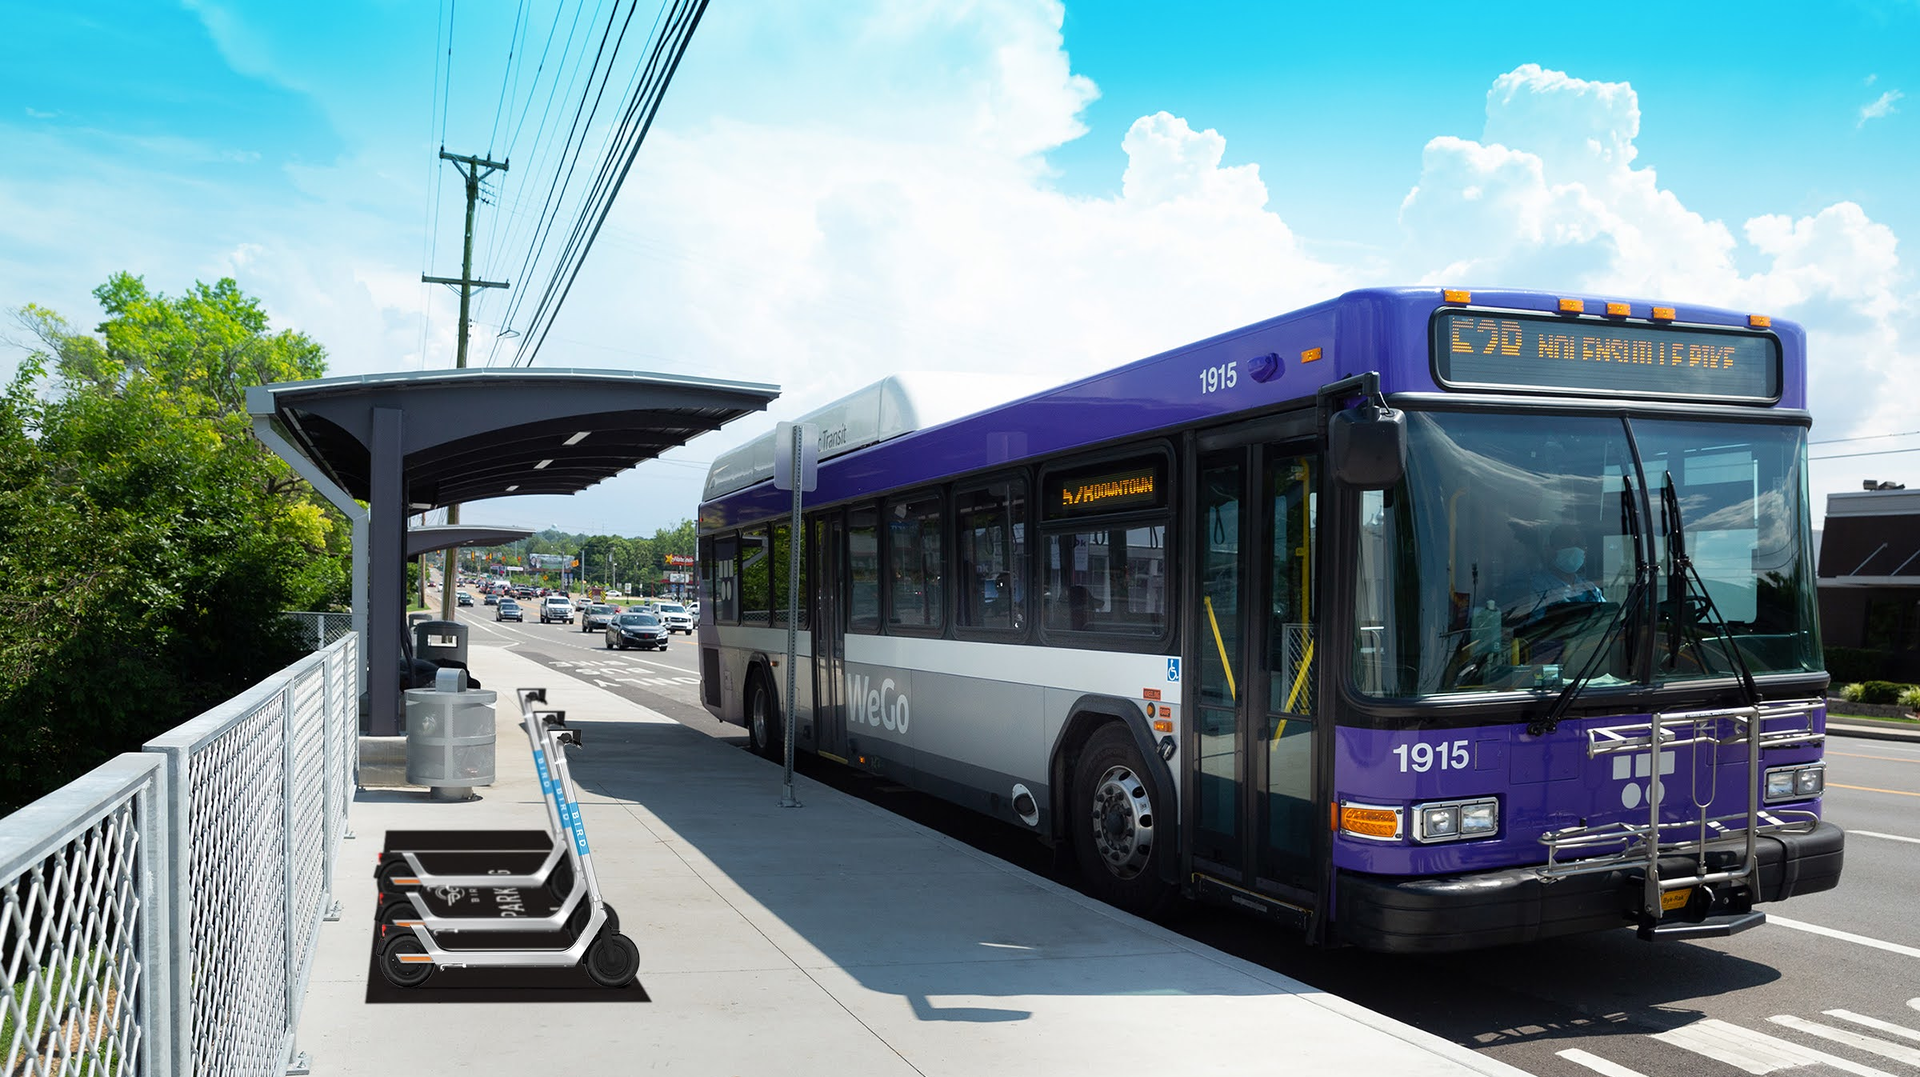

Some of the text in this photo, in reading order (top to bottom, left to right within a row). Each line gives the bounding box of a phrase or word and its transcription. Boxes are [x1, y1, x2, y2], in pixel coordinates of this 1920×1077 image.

[1199, 361, 1238, 394] 1915
[822, 423, 847, 451] Transit
[575, 667, 656, 675] BUS
[847, 673, 910, 734] WeGo
[537, 757, 551, 788] BIRD
[1393, 740, 1470, 773] 1915
[556, 787, 570, 821] BIRD
[572, 810, 587, 847] BIRD
